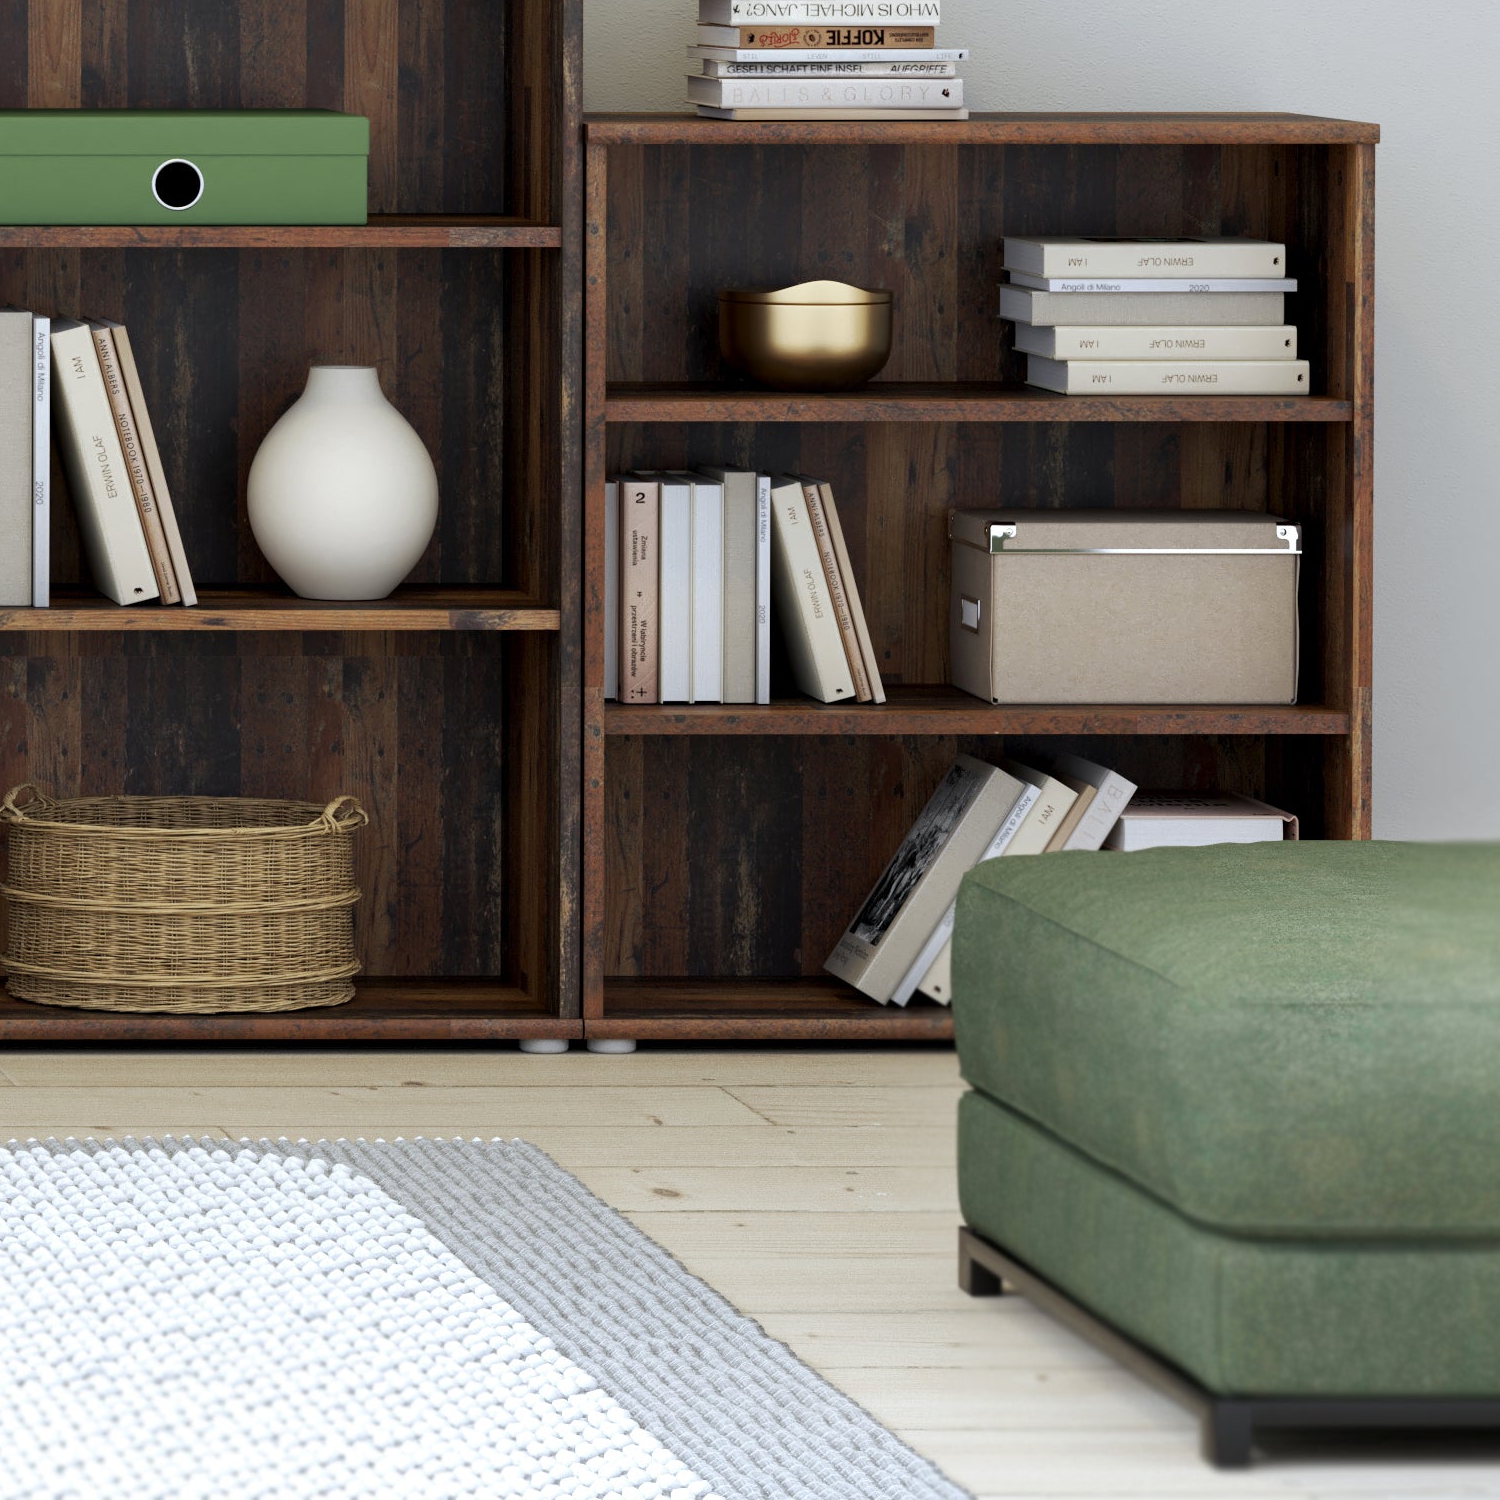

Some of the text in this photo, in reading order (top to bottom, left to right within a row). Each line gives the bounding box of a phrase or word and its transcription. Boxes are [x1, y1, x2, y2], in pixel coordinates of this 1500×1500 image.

[746, 3, 939, 17] WHO IS MICHAEL JANG?
[759, 28, 800, 48] STORIES
[826, 29, 885, 45] KOFFIE
[821, 87, 831, 101] &
[844, 85, 930, 101] GLORY
[1068, 258, 1083, 267] AM
[1137, 257, 1194, 267] ERWIN OLAF
[1061, 283, 1121, 292] Angoli di Milano
[1188, 284, 1210, 292] 2020
[1079, 340, 1095, 348] AM
[1149, 339, 1206, 349] ERWIN OLAF
[35, 332, 46, 402] Angoli di Milano
[72, 356, 85, 373] AM
[98, 338, 120, 395] ANNI ALBERS
[1092, 375, 1107, 383] AM
[1161, 374, 1218, 383] ERWIN OLAF
[118, 413, 139, 463] NOTEBOOK
[92, 435, 118, 499] ERWIN OLAF
[35, 481, 44, 505] 2020
[635, 492, 646, 504] 2
[787, 506, 797, 521] AM
[803, 568, 823, 620] ERWIN OLAF
[758, 605, 766, 624] 2020
[630, 605, 638, 644] przestrzeni
[640, 620, 648, 628] W
[1041, 804, 1055, 821] AM
